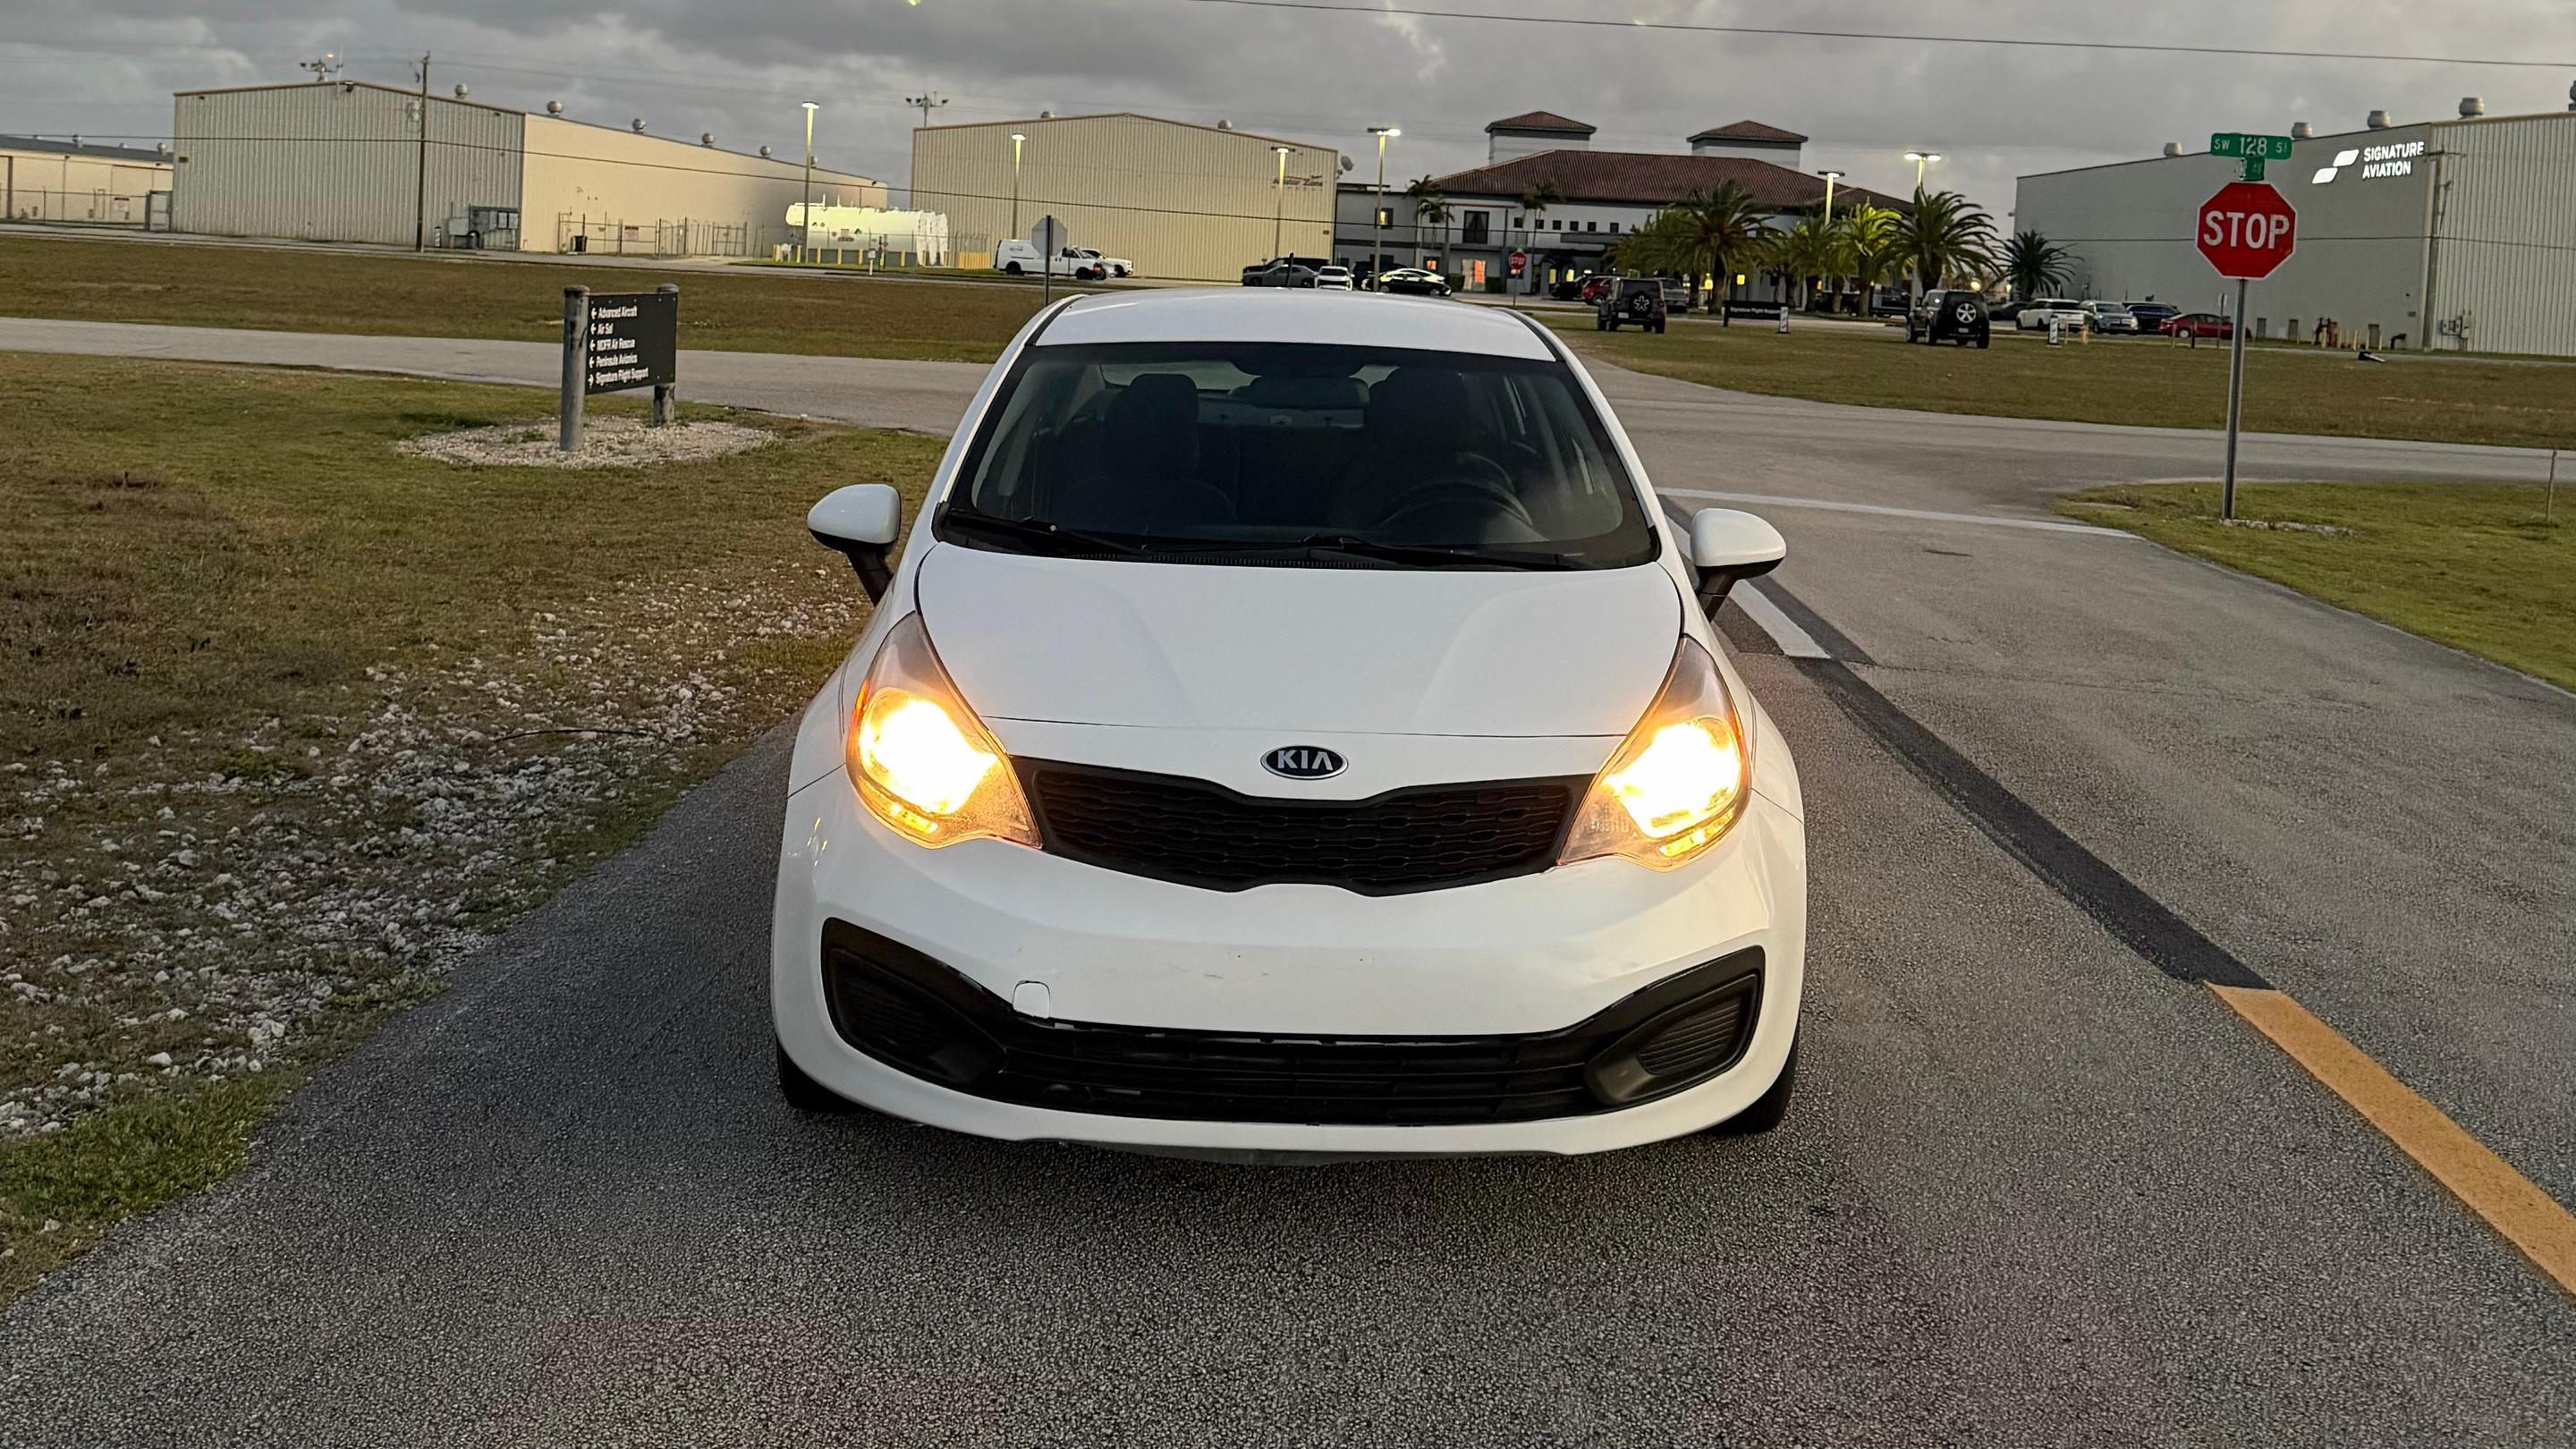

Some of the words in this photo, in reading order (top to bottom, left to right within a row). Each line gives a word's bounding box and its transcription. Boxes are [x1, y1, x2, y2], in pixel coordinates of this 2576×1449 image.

[2214, 139, 2230, 150] SW
[2241, 137, 2267, 156] 128
[2363, 141, 2425, 162] SIGNATURE
[2362, 161, 2411, 179] AVIATION
[2203, 210, 2290, 250] STOP
[597, 306, 622, 319] Advanced
[597, 323, 606, 335] Air
[595, 371, 618, 386] Signature
[618, 369, 631, 383] Flight
[631, 367, 649, 382] Support
[1277, 750, 1334, 771] KIA
